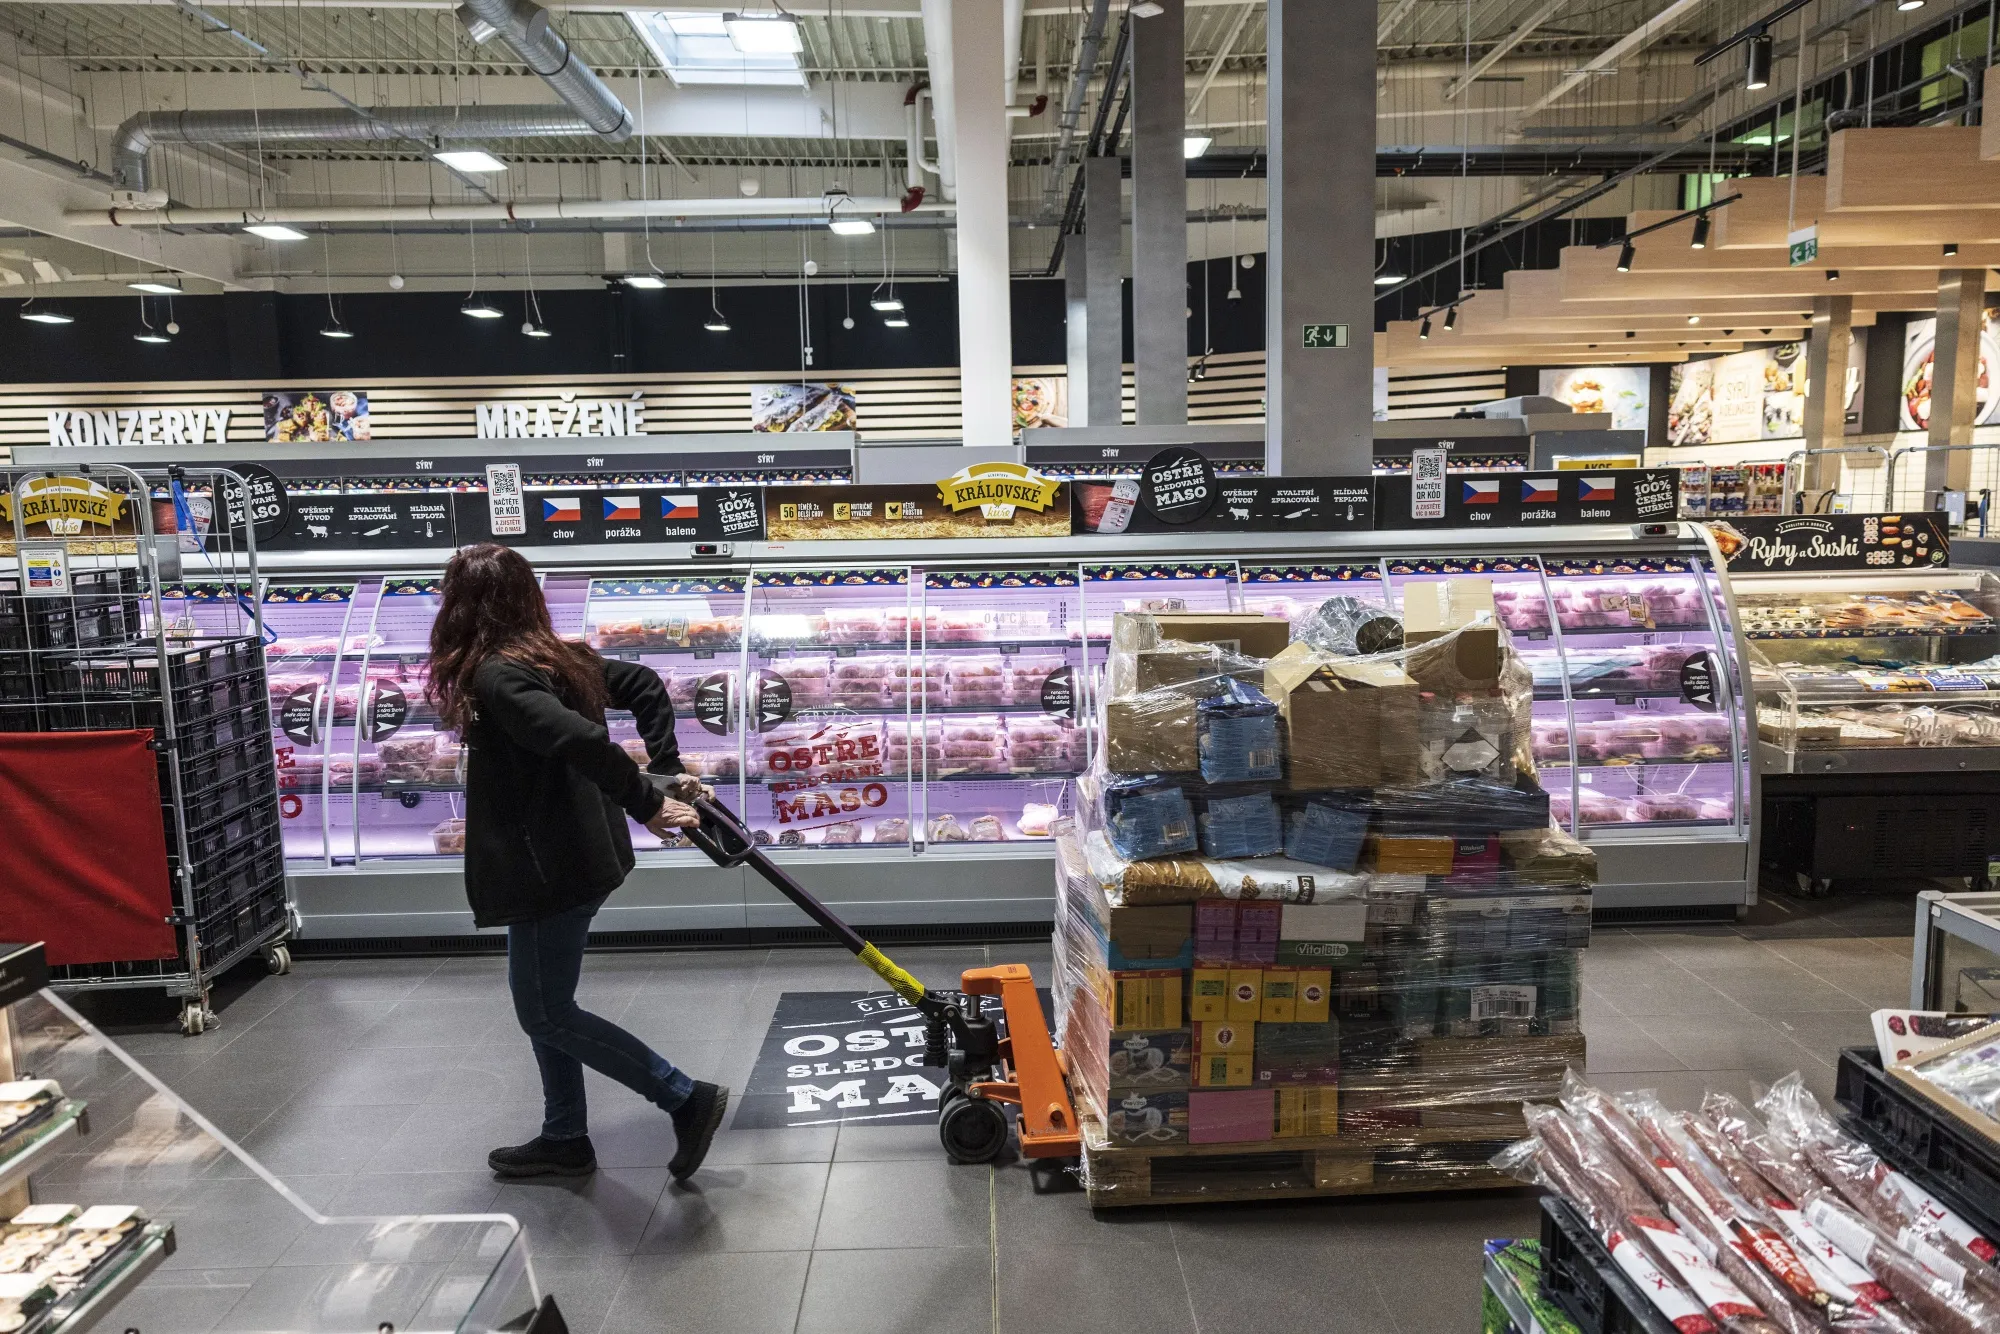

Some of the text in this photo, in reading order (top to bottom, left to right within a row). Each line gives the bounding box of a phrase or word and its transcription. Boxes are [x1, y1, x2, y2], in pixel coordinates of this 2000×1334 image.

[475, 391, 648, 439] MRAŽENÉ
[48, 408, 231, 447] KONZERVY
[1102, 447, 1119, 457] SÝRY
[587, 456, 604, 467] SÝRY
[757, 453, 774, 464] SÝRY
[416, 460, 433, 470] SÝRY
[1152, 463, 1203, 483] OSTŘE
[1154, 476, 1205, 493] SLEDOVANÉ
[1634, 479, 1671, 496] 100%
[955, 481, 1041, 504] KRÁLOVSKÉ
[1155, 486, 1207, 506] MASO
[1222, 488, 1258, 497] OVĚŘENÝ
[1277, 488, 1314, 496] KVALITNÍ
[1333, 487, 1369, 495] HLÍDANÁ
[1416, 490, 1440, 499] QR KÓD
[493, 498, 519, 506] NAČTĚTE
[1636, 489, 1673, 505] ČESKÉ
[23, 496, 108, 518] KRÁLOVSKÉ
[298, 505, 334, 514] OVĚŘENÝ
[353, 504, 391, 513] KVALITNÍ
[410, 504, 445, 512] HLÍDANÁ
[495, 504, 520, 515] QR KÓD
[718, 497, 755, 514] 100%
[1637, 500, 1674, 514] KUŘECÍ
[304, 513, 330, 521] PŮVOD
[720, 507, 758, 523] ČESKÉ
[784, 507, 794, 518] 56
[903, 508, 923, 516] PROSTOR
[987, 506, 1010, 517] kuře
[1470, 512, 1491, 520] chov
[1521, 510, 1557, 521] porážka
[1581, 508, 1611, 517] baleno
[723, 518, 759, 533] KUŘECÍ
[553, 529, 575, 538] chov
[605, 528, 641, 539] porážka
[666, 527, 696, 536] baleno
[1749, 536, 1799, 566] Ryby
[1807, 535, 1859, 558] Sushi
[1904, 714, 1955, 747] Ryby
[769, 731, 880, 773] OSTŘE
[774, 760, 883, 793] SLEDOVANÉ
[776, 783, 888, 824] MASO
[1299, 943, 1347, 955] VitalBite
[787, 1053, 924, 1078] SLEDO
[786, 1074, 940, 1113] MA
